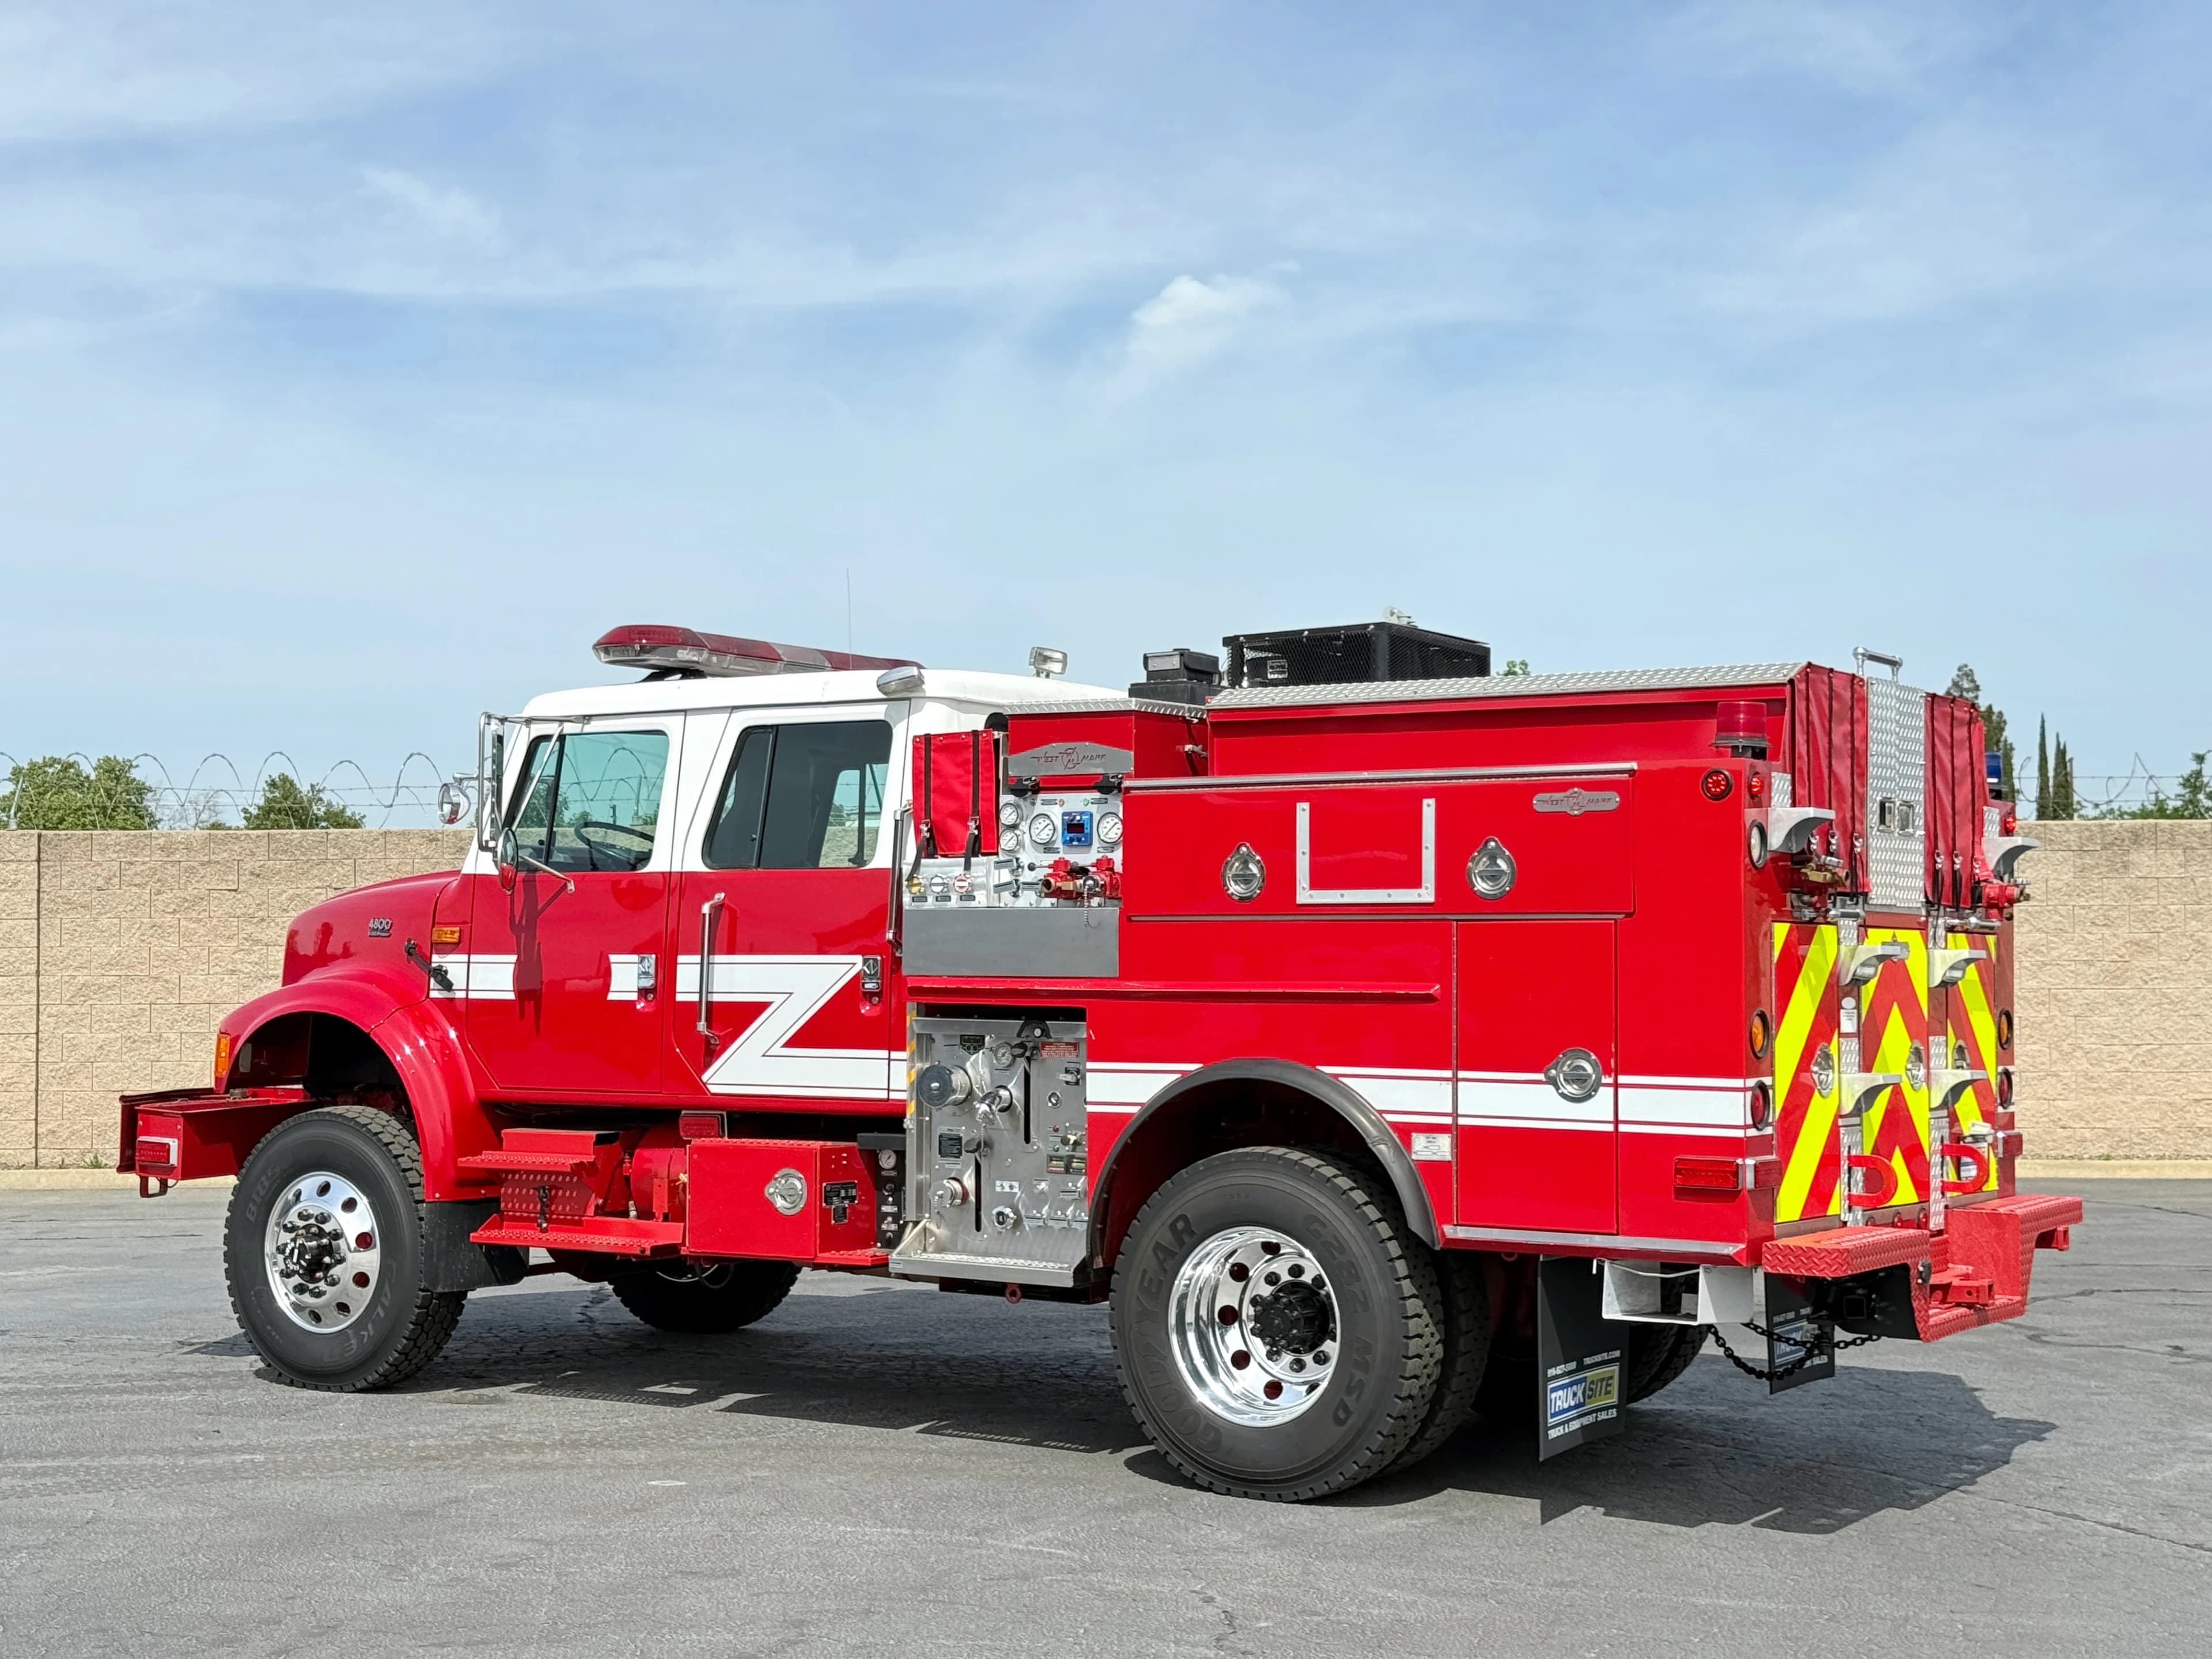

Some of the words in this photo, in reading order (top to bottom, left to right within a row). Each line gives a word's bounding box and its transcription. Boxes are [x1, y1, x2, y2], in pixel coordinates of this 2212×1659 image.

[369, 918, 391, 929] 4800
[1302, 1213, 1370, 1313] G282
[1132, 1213, 1222, 1453] GOODYEAR
[1331, 1334, 1373, 1428] MSD
[1551, 1382, 1585, 1414] TRUCK
[1587, 1376, 1613, 1400] SITE
[1548, 1425, 1565, 1440] TRUCK
[1597, 1408, 1618, 1421] SALES
